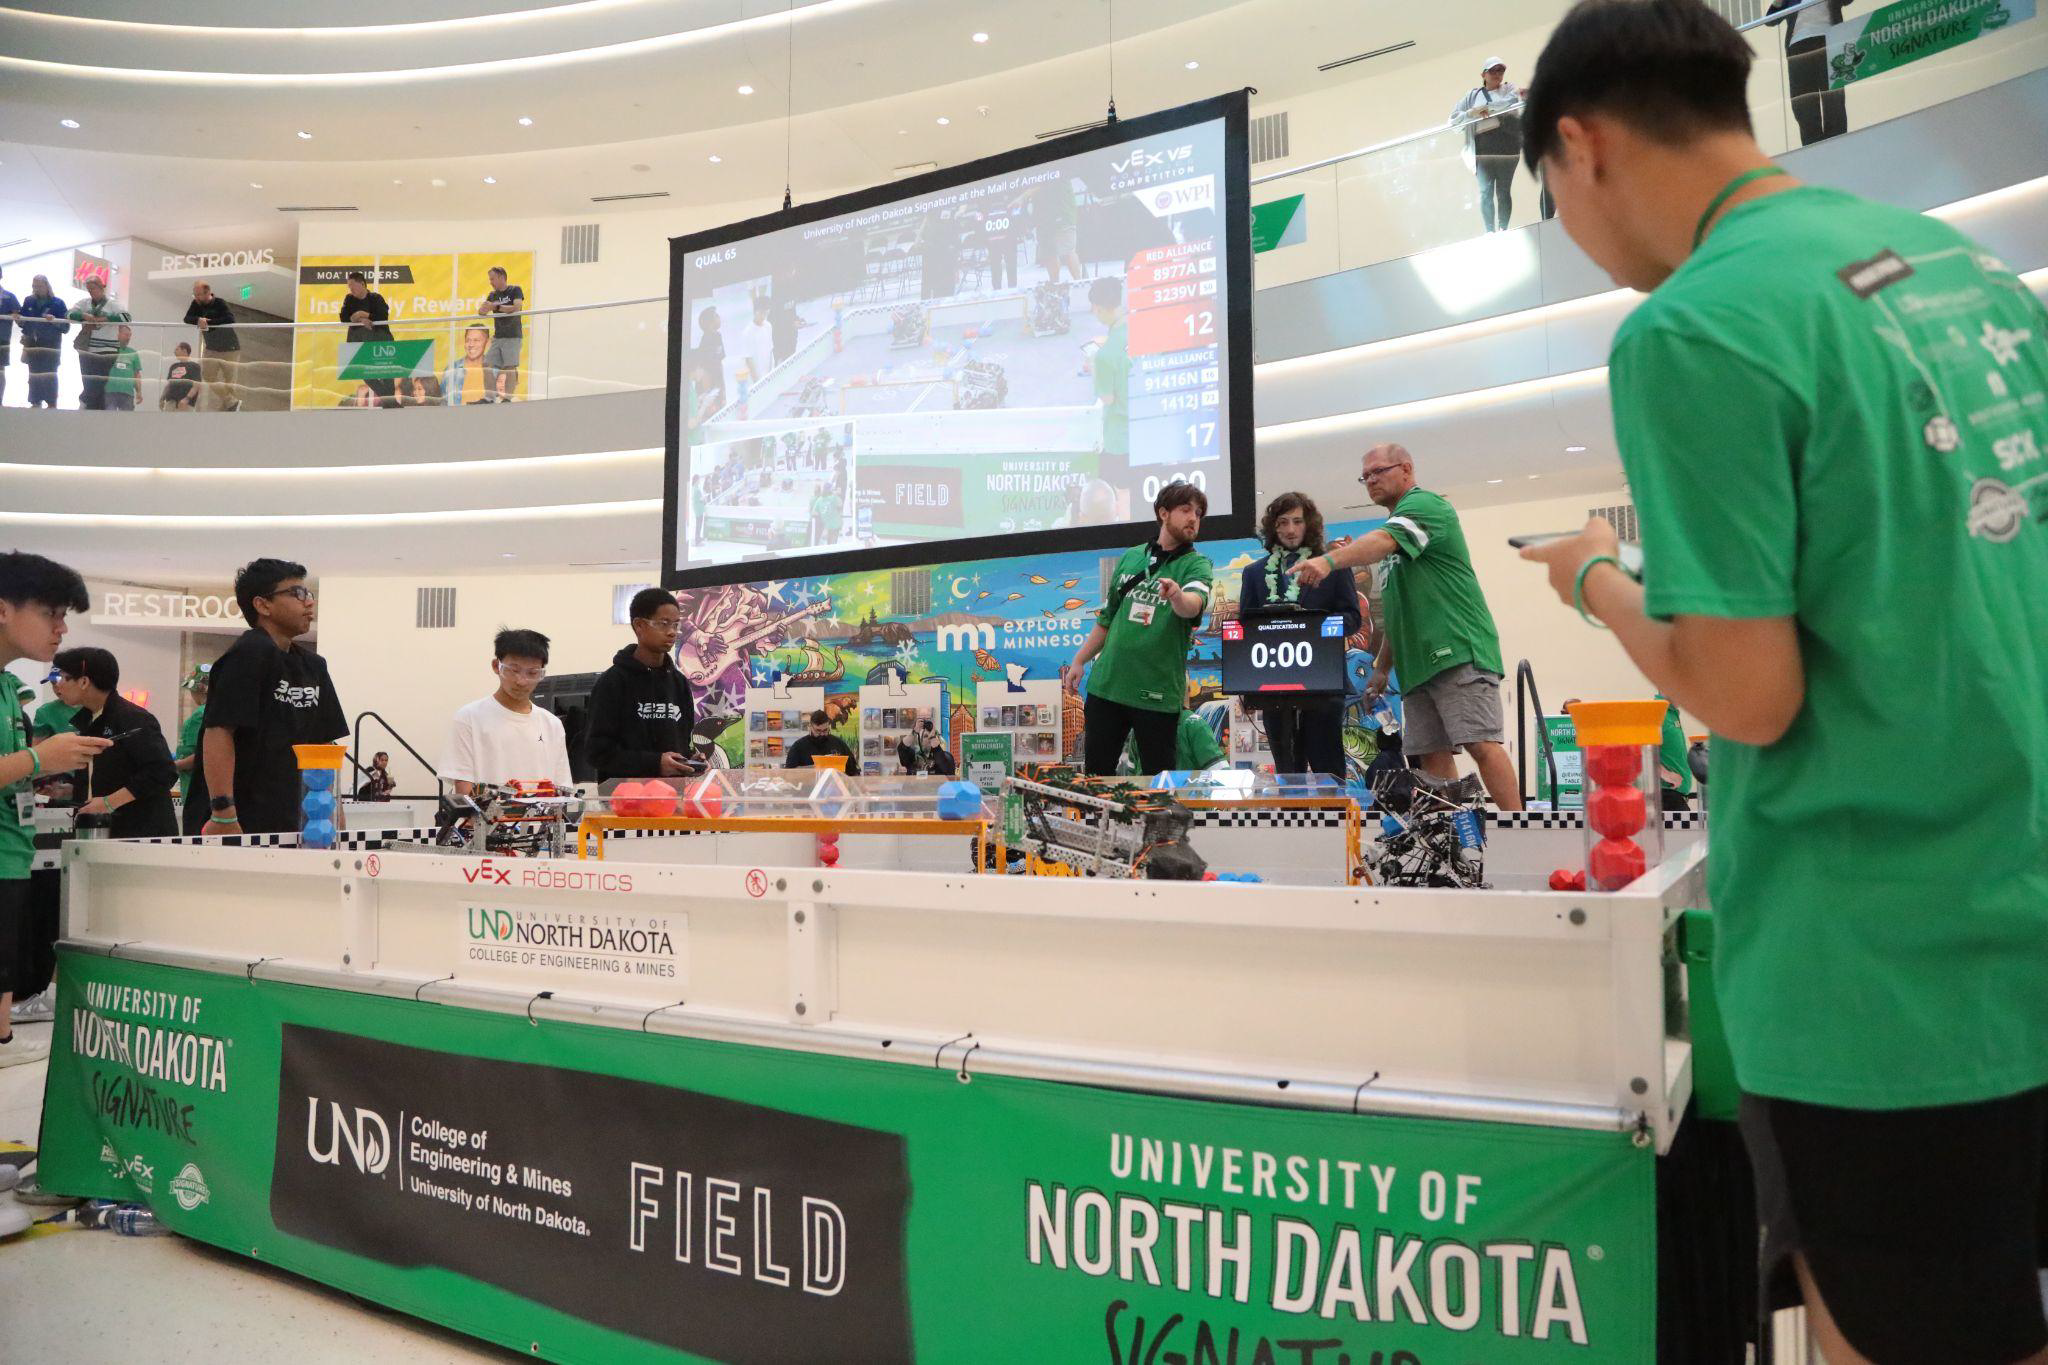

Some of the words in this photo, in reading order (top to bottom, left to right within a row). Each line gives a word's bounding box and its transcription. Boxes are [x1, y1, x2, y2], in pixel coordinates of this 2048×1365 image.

[1870, 13, 1923, 46] NORTH
[1888, 17, 1971, 59] SIGNATURE
[1111, 149, 1164, 173] VEX
[1110, 166, 1194, 190] COMPETITION
[803, 223, 844, 240] University
[845, 219, 854, 229] of
[856, 212, 881, 226] North
[883, 205, 912, 220] Dakota
[914, 194, 956, 213] Signature
[959, 190, 969, 201] at
[970, 186, 985, 198] the
[988, 181, 1007, 194] Mall
[1009, 177, 1019, 188] of
[1021, 169, 1060, 186] America
[1175, 183, 1210, 204] WPI
[985, 217, 1009, 231] 0:00
[162, 248, 274, 271] RESTROOMS
[695, 252, 722, 268] QUAL
[725, 248, 737, 261] 65
[1146, 251, 1164, 261] RED
[1166, 240, 1212, 257] ALLIANCE
[1153, 262, 1197, 281] 8977A
[1154, 284, 1197, 303] 3239V
[1184, 311, 1214, 336] 12
[1142, 357, 1166, 370] BLUE
[1168, 350, 1215, 367] ALLIANCE
[1144, 371, 1197, 391] 91416N
[1161, 394, 1198, 411] 1412J
[1185, 422, 1215, 447] 17
[1002, 460, 1056, 472] UNIVERSITY
[1058, 461, 1072, 472] OF
[895, 483, 949, 506] FIELD
[986, 474, 1030, 492] NORTH
[1002, 494, 1067, 513] SIGNATUR
[104, 592, 243, 617] RESTROO
[1227, 630, 1239, 639] 12
[1327, 626, 1339, 635] 17
[1251, 641, 1313, 668] 0:00
[462, 859, 512, 885] VEX
[522, 870, 633, 892] ROBOTICS
[468, 908, 513, 941] UND
[516, 911, 636, 927] UNIVERSITY
[649, 919, 669, 929] OF
[516, 922, 583, 948] NORTH
[589, 927, 674, 955] DAKOTA
[469, 947, 518, 964] COLLEGE
[521, 951, 537, 965] OF
[540, 953, 620, 974] ENGINEERING
[624, 961, 631, 973] &
[636, 962, 675, 978] MINES
[87, 981, 177, 1021] UNIVERSITY
[181, 997, 202, 1024] OF
[73, 1007, 133, 1067] NORTH
[135, 1023, 226, 1093] DAKOTA
[92, 1070, 197, 1147] SIGNATURE
[307, 1096, 391, 1175] UND
[411, 1115, 466, 1149] College
[471, 1131, 487, 1149] of
[124, 1154, 154, 1180] VEX
[410, 1142, 501, 1185] Engineering
[506, 1165, 518, 1183] &
[523, 1168, 572, 1197] Mines
[1109, 1133, 1397, 1213] UNIVERSITY
[1419, 1171, 1482, 1225] OF
[411, 1176, 472, 1210] University
[476, 1192, 490, 1210] of
[493, 1196, 531, 1222] North
[630, 1161, 847, 1297] FIELD
[1026, 1179, 1252, 1304] NORTH
[1270, 1213, 1589, 1347] DAKOTA
